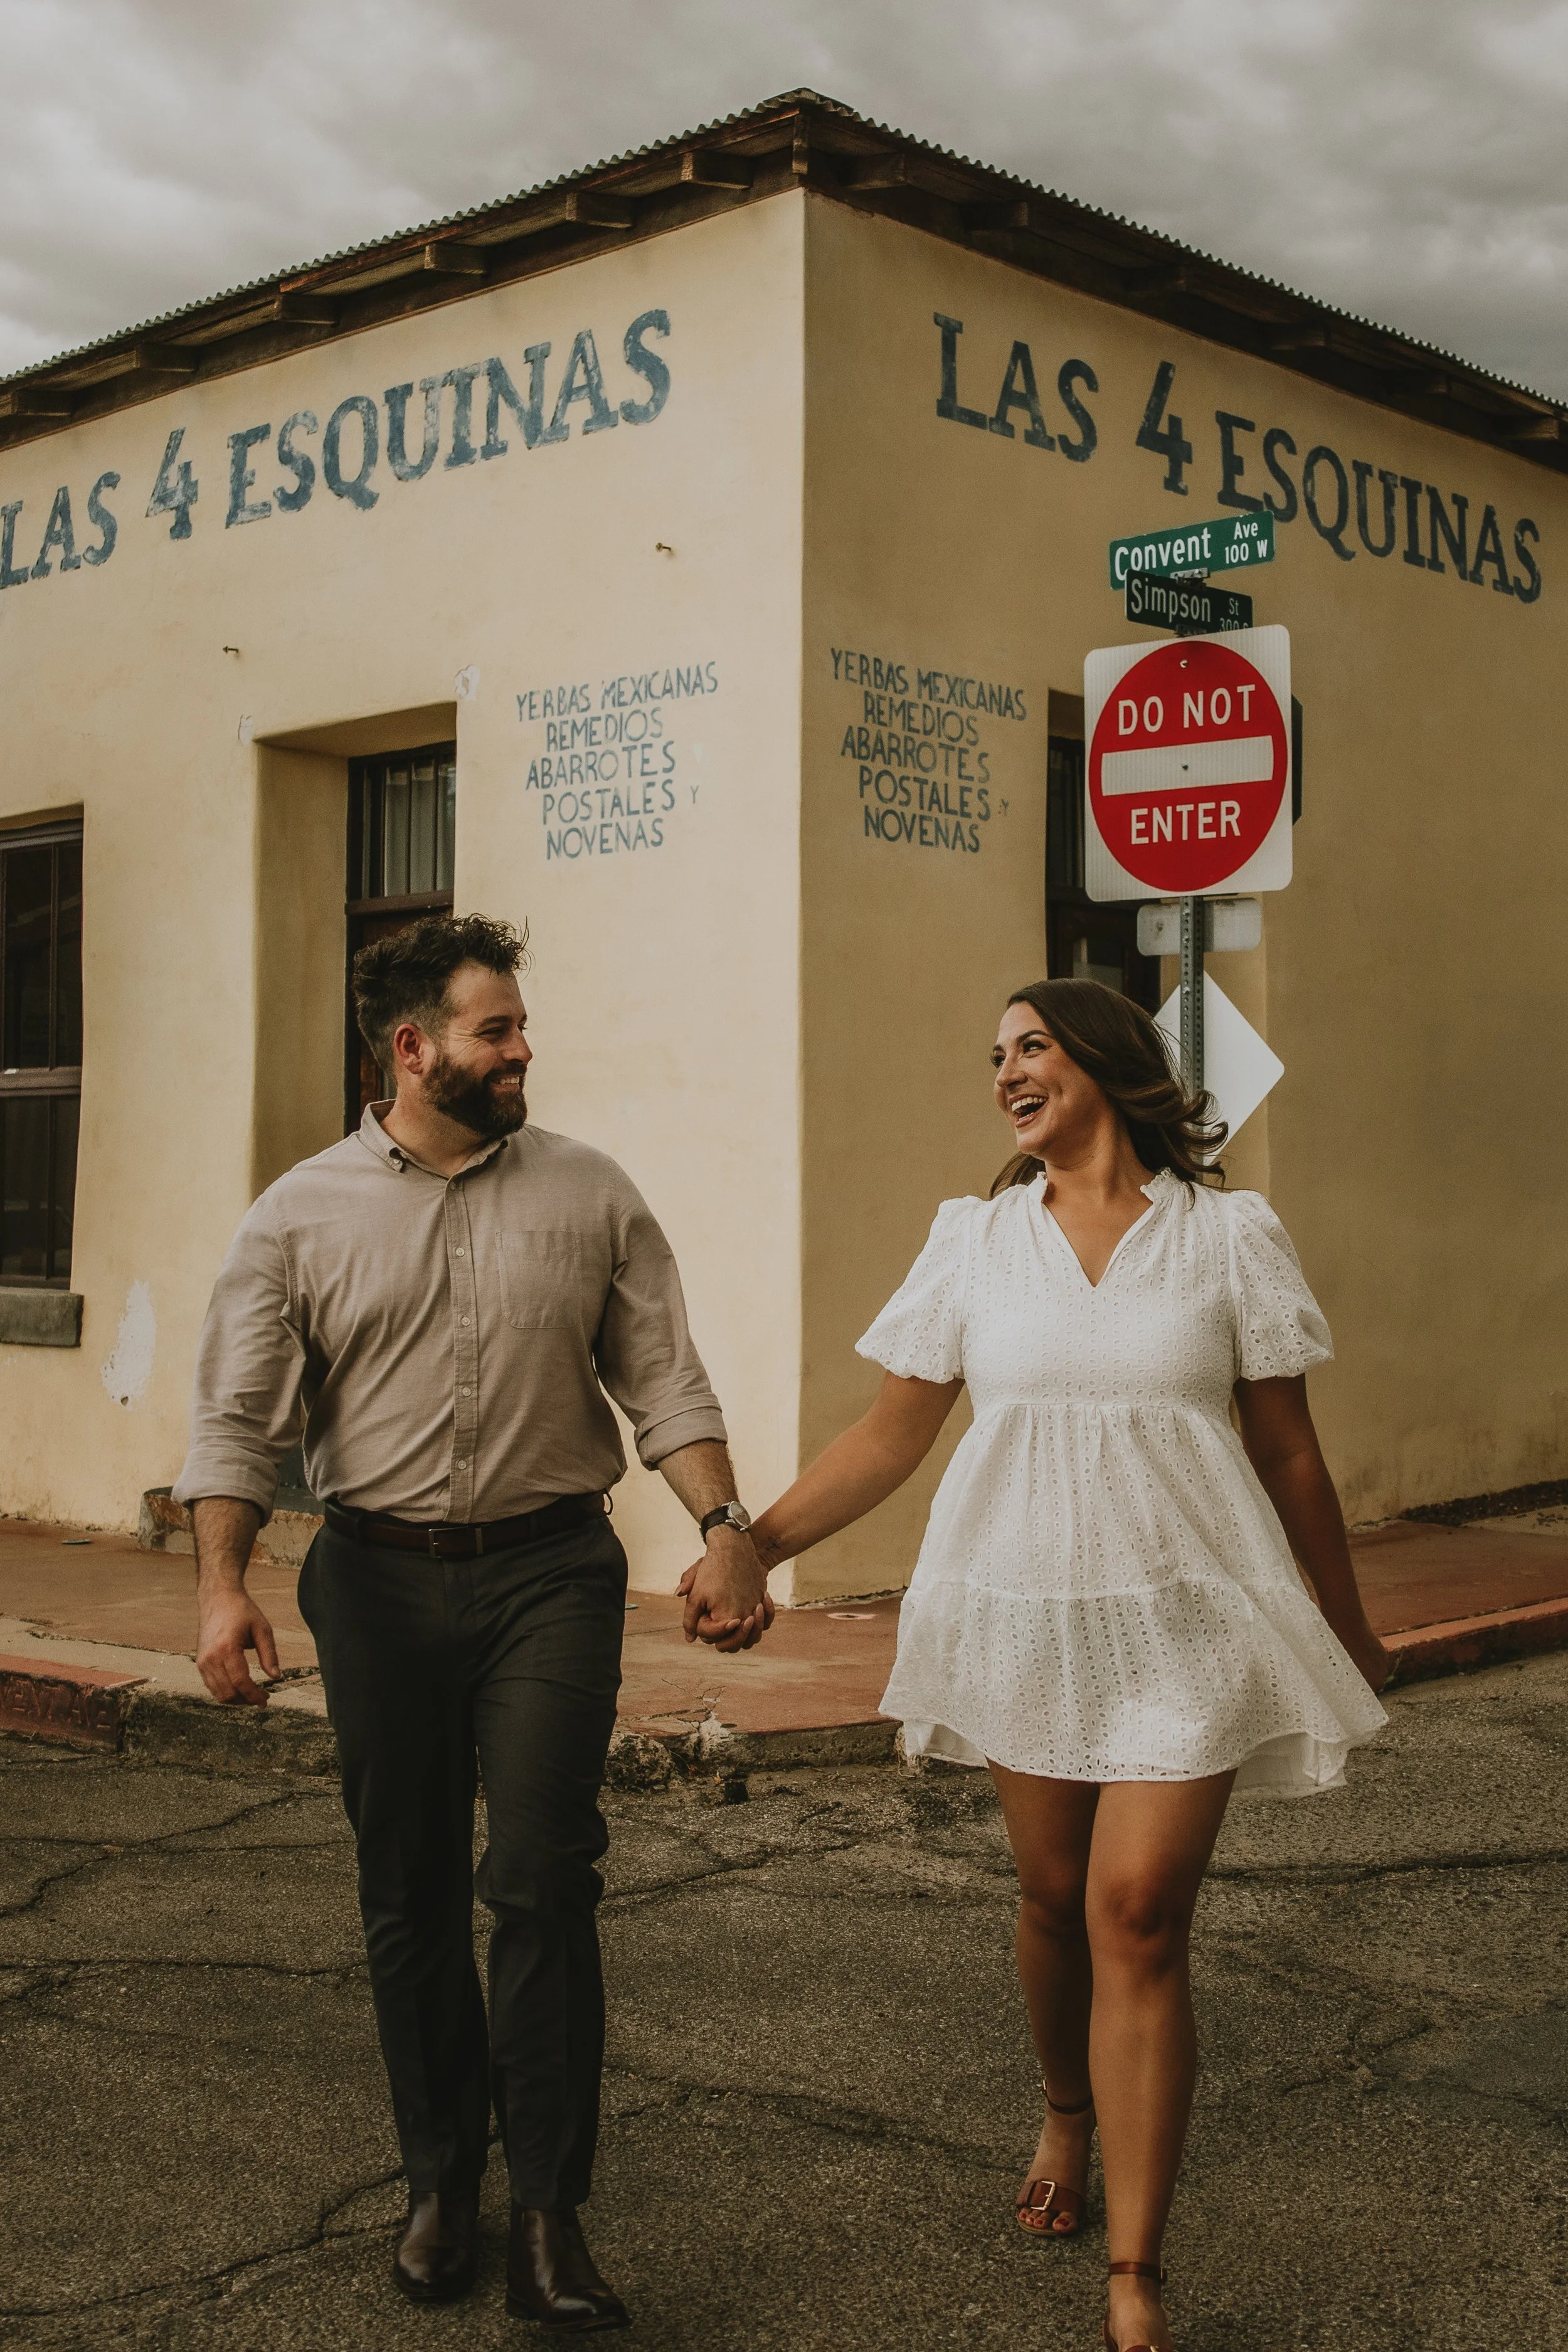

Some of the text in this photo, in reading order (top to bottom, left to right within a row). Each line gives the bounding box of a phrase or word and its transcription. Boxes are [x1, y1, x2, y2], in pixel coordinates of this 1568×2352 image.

[0, 309, 672, 590] LAS 4 ESQUINAS
[933, 312, 1542, 603] LAS 4 ESQUINAS
[1115, 522, 1258, 581] Convent Ave
[1225, 539, 1268, 564] 100 W
[1130, 578, 1239, 623] Simpson St
[516, 661, 718, 722] YERBAS MEXICANAS
[831, 647, 1027, 721] YERBAS MEXICANAS
[1118, 684, 1256, 736] DO NOT
[546, 706, 663, 753] REMEDIOS
[864, 690, 979, 746] REMEDIOS
[526, 740, 675, 790] ABARROTES
[841, 725, 991, 783] ABARROTES
[543, 778, 699, 825] POSTALES Y
[859, 765, 991, 821] POSTALES
[546, 817, 664, 861] NOVENAS
[864, 804, 980, 853] NOVENAS
[1130, 800, 1241, 845] ENTER
